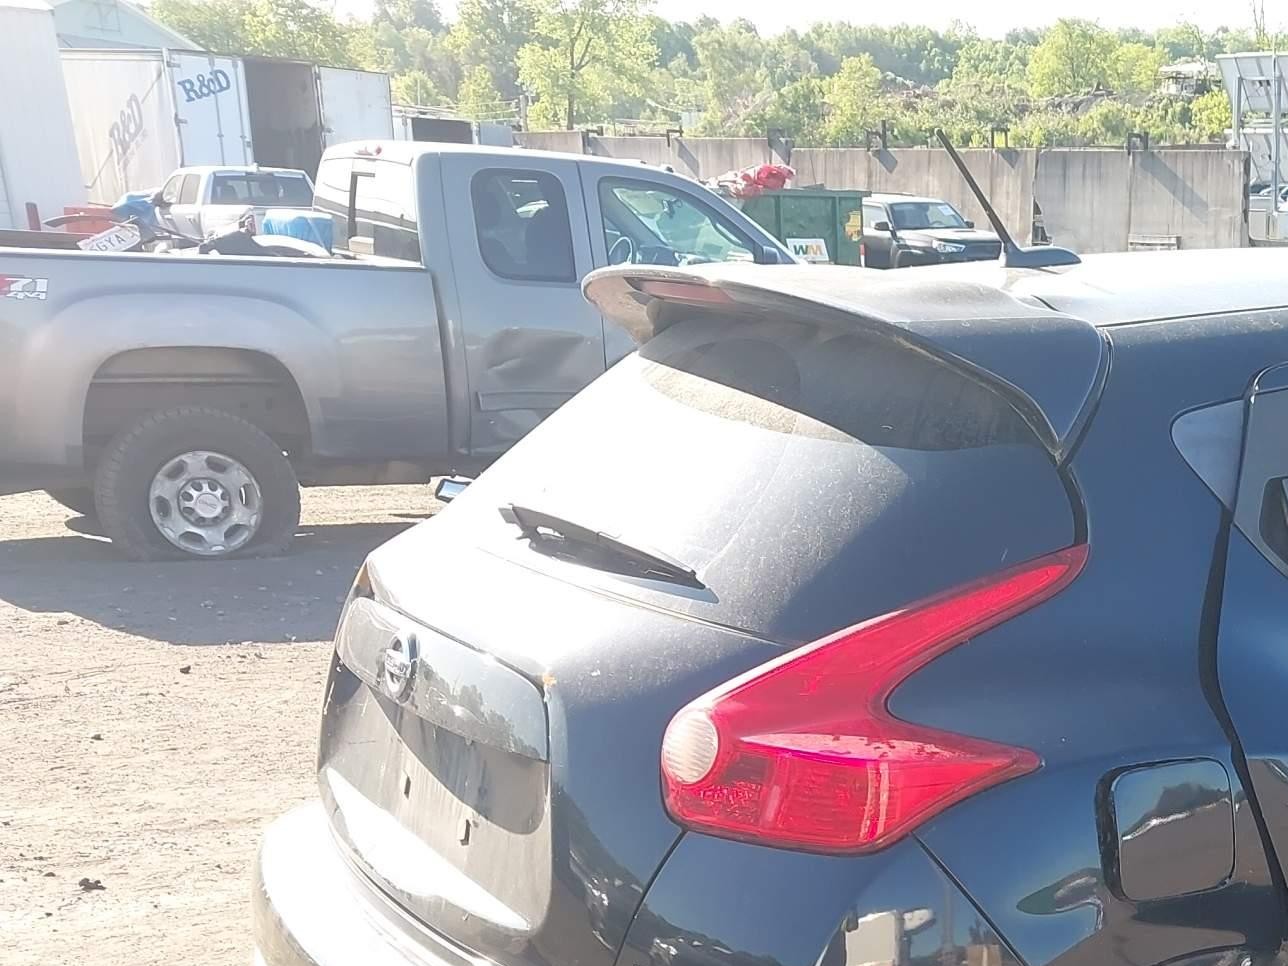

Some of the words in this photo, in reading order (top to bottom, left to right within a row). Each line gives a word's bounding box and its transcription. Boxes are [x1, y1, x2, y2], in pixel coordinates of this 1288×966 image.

[177, 69, 231, 102] R&D
[109, 93, 144, 162] R&D
[793, 244, 823, 256] WM
